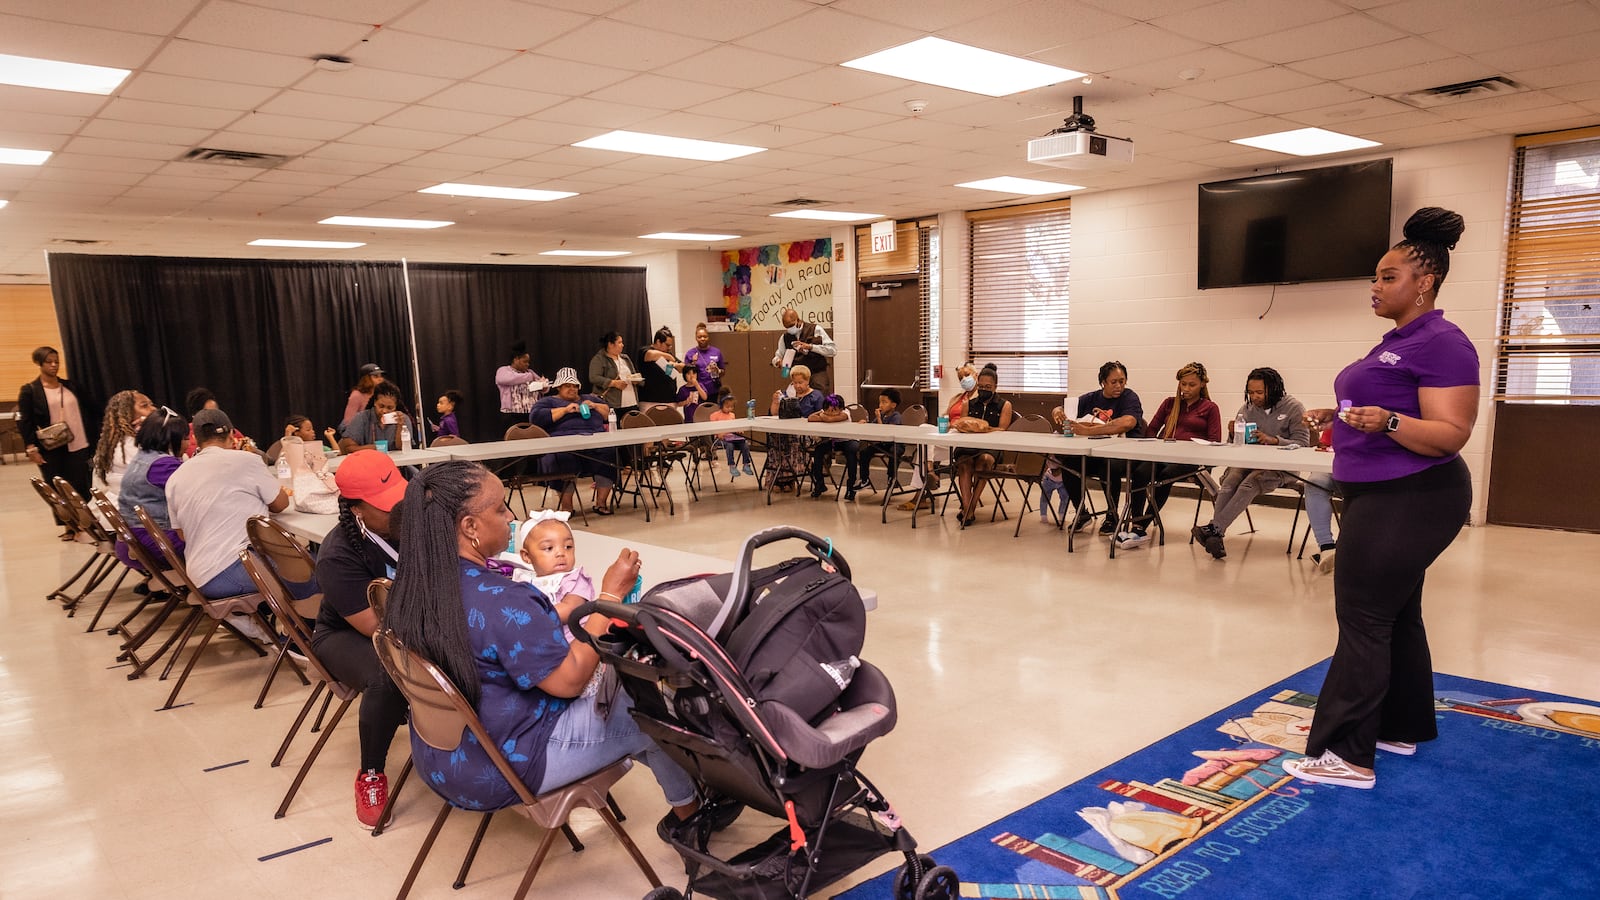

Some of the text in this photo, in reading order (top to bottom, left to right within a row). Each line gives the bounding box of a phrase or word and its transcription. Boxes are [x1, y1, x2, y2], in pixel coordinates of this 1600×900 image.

[874, 234, 893, 252] EXIT
[752, 289, 782, 326] Today
[787, 278, 794, 291] a
[1480, 718, 1561, 740] READ
[1138, 796, 1312, 900] READ TO SUCCEED
